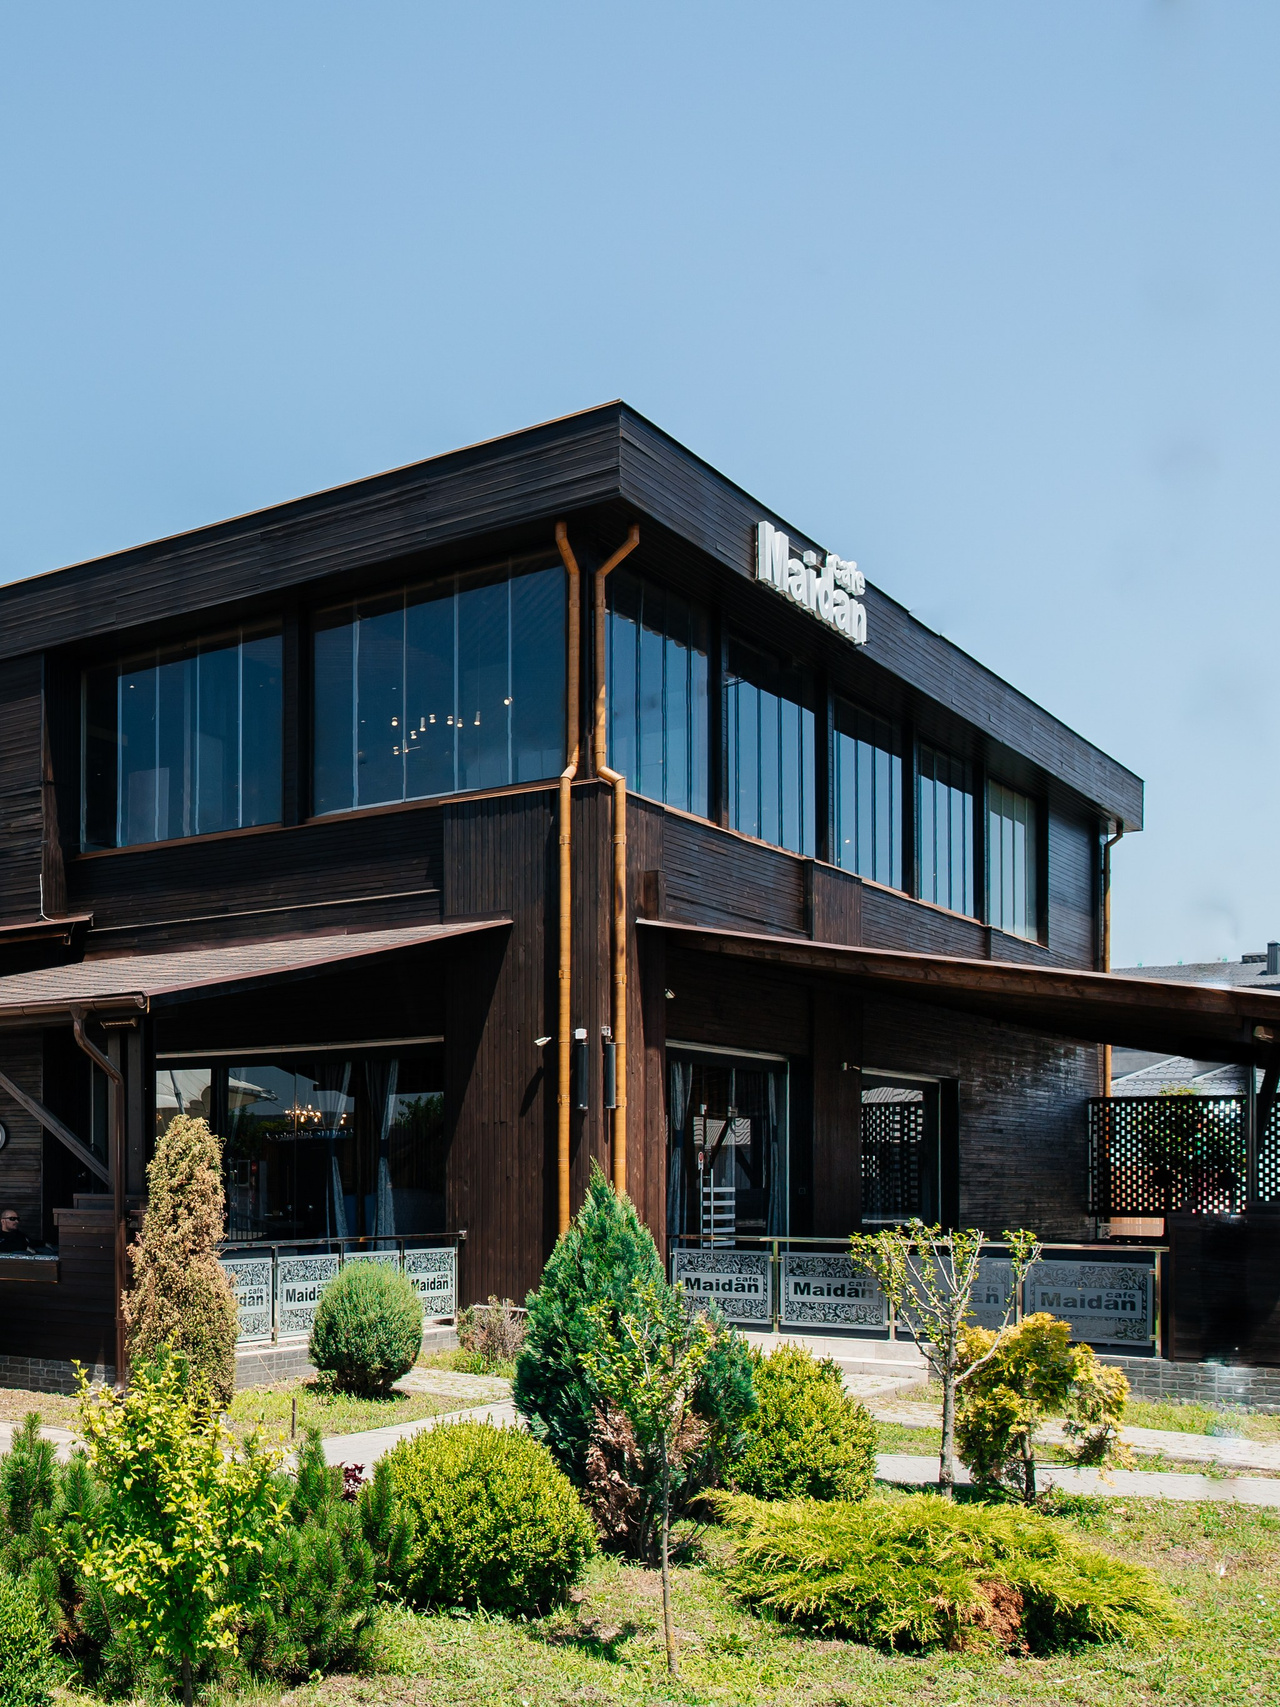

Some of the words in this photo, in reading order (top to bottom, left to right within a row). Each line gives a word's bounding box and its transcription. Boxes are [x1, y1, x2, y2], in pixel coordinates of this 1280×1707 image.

[758, 520, 867, 646] Maidan
[685, 1277, 759, 1294] Maidan
[793, 1281, 874, 1299] Maidan
[285, 1286, 324, 1303] Maida
[1040, 1291, 1137, 1312] Maidan
[1105, 1291, 1136, 1300] cafe
